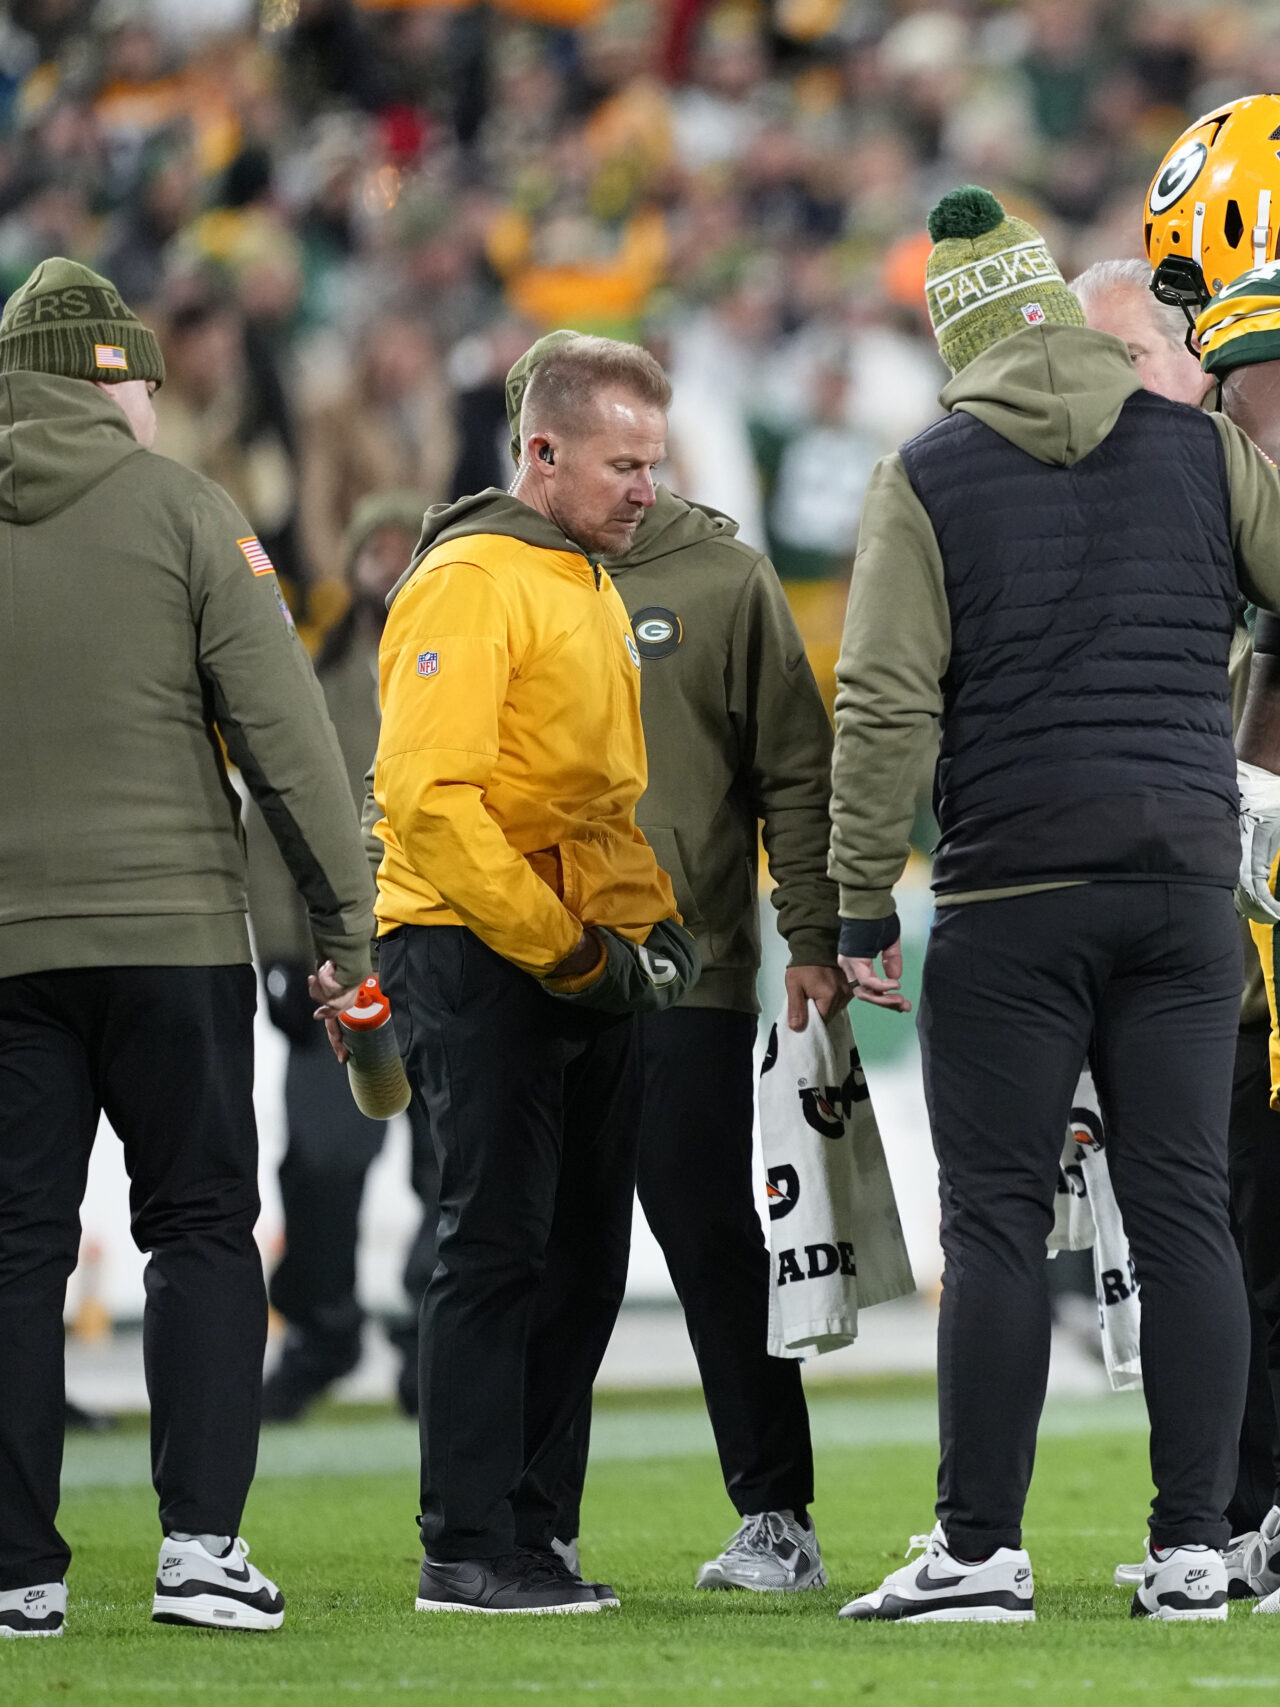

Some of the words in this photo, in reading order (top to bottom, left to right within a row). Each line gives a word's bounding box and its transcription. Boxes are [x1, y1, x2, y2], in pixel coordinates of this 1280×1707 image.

[419, 661, 436, 673] NFL
[166, 1557, 184, 1565] NIKE
[1188, 1568, 1209, 1577] NIKE
[26, 1590, 47, 1598] NIKE
